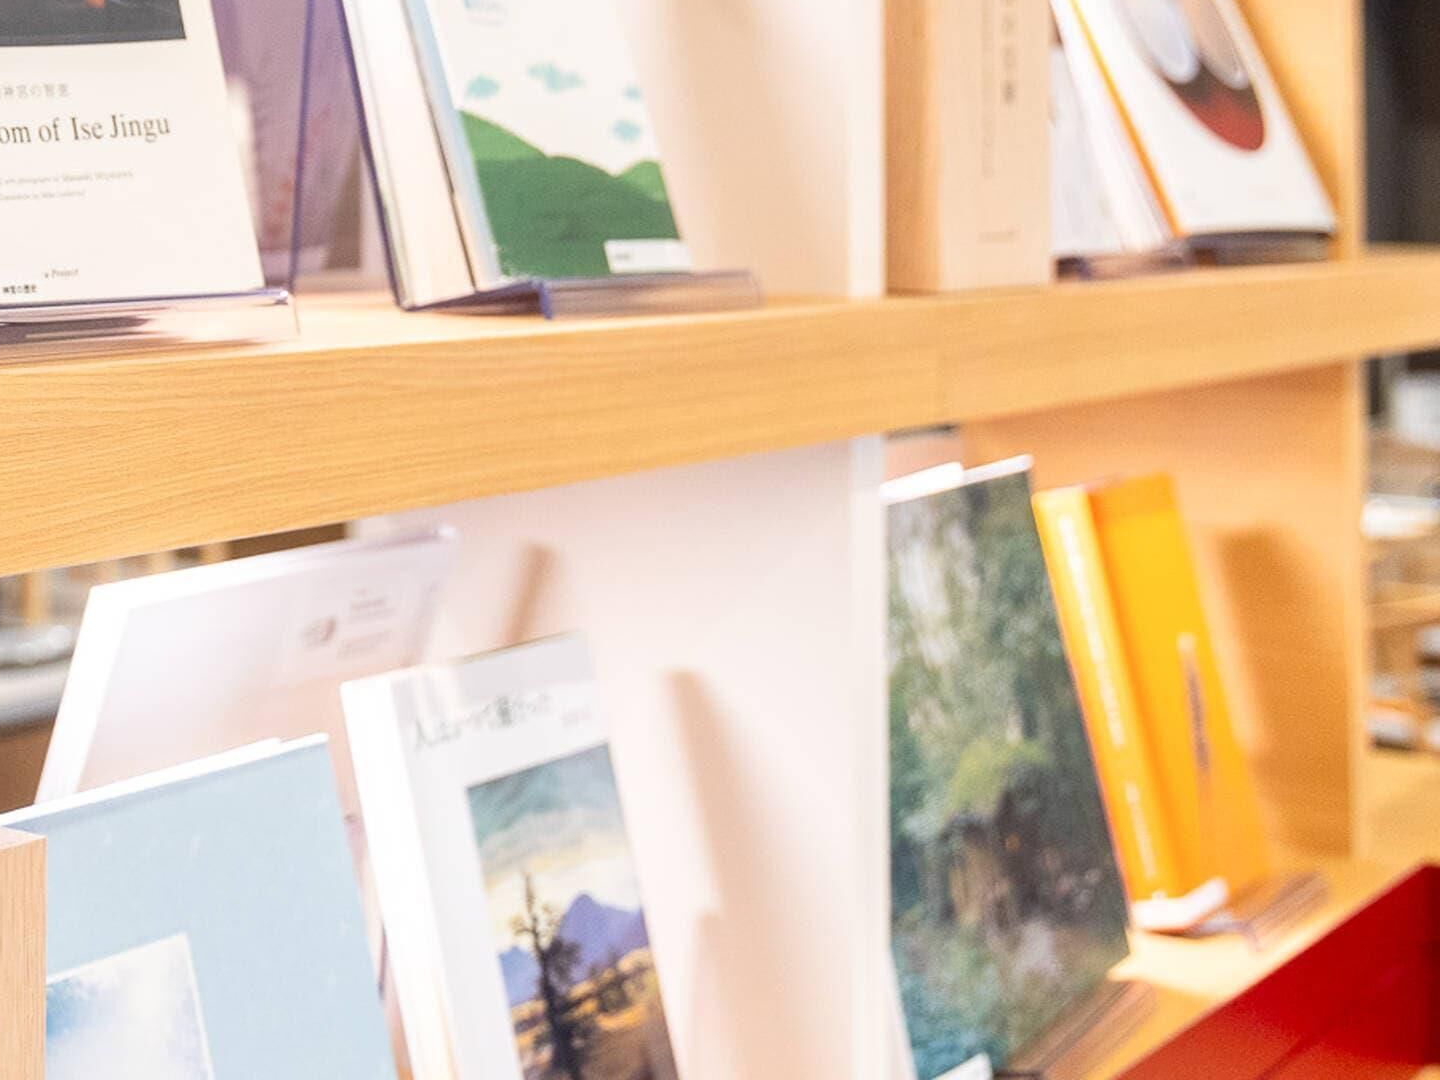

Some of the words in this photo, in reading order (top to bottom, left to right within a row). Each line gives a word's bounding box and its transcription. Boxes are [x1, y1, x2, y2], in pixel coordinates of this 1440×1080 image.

[38, 118, 60, 143] of
[71, 117, 103, 141] Ise
[109, 114, 171, 143] Jingu
